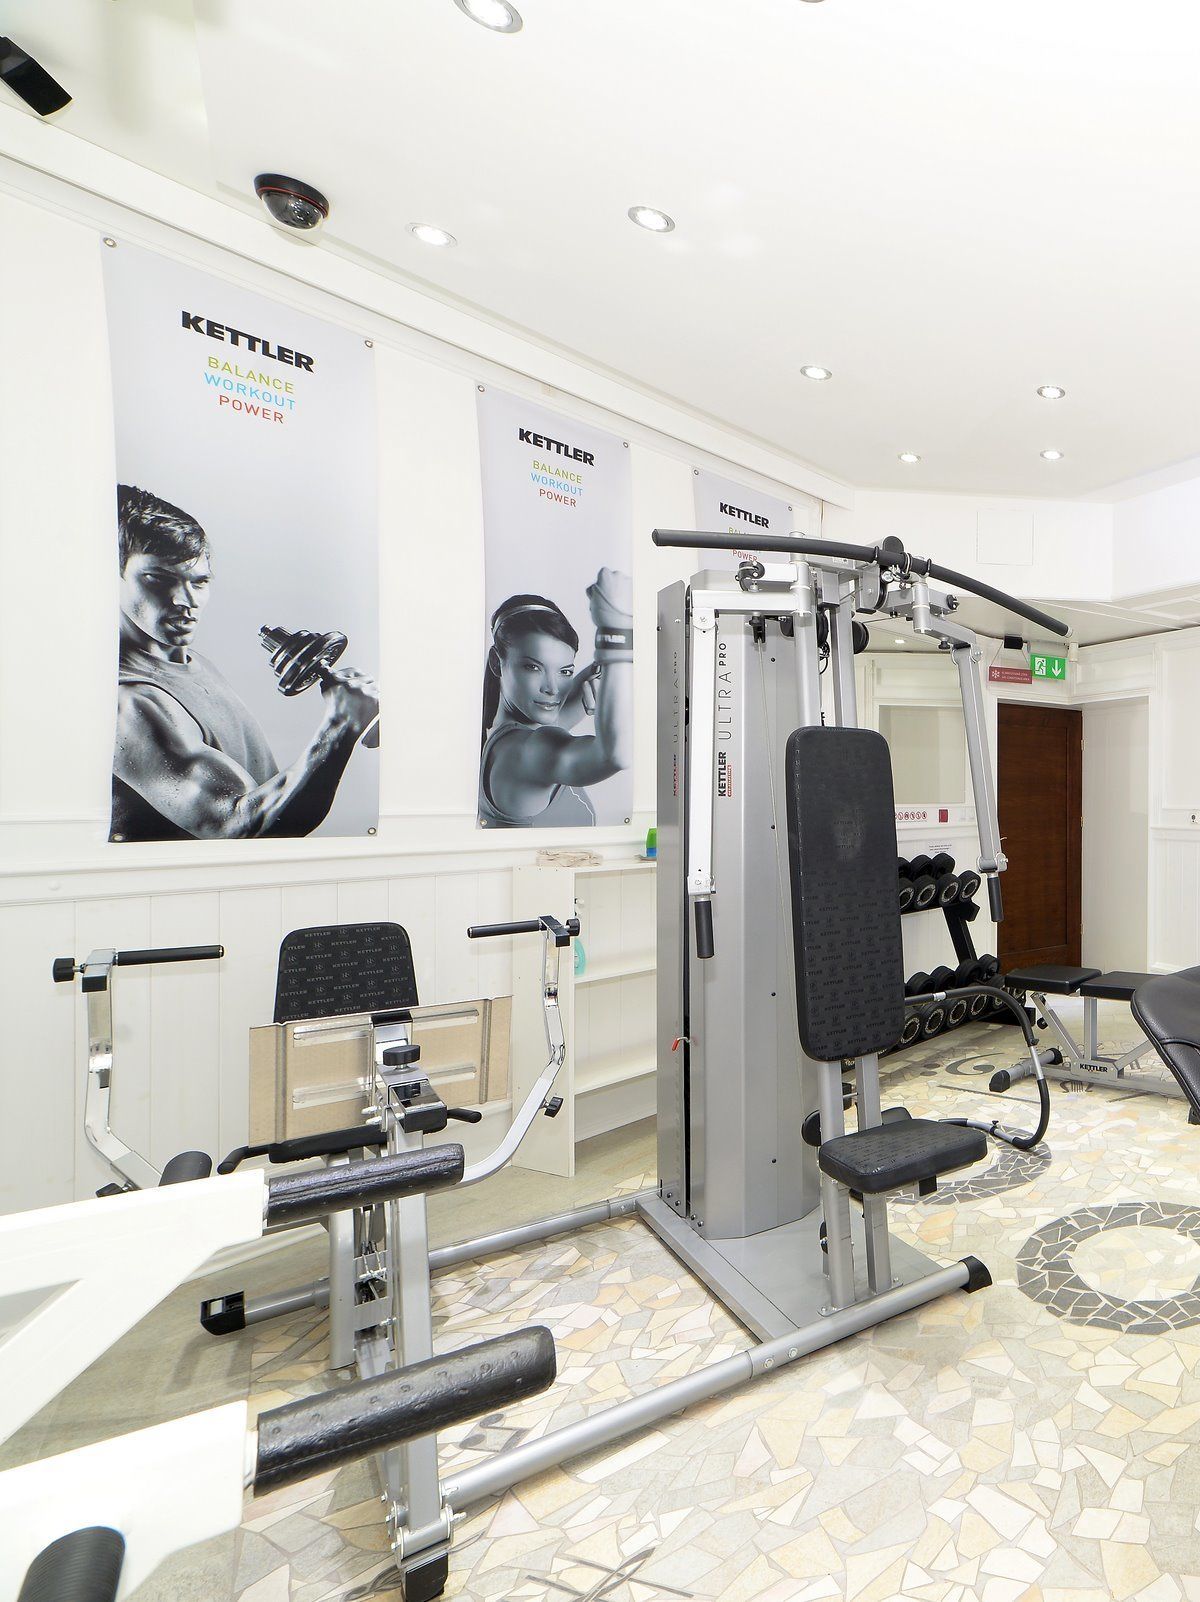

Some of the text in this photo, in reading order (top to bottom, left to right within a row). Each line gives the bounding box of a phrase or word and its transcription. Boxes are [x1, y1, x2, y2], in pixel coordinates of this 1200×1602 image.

[181, 310, 314, 373] KETTLER
[208, 356, 295, 394] BALANCE
[204, 372, 296, 410] WORKOUT
[219, 394, 284, 424] POWER
[519, 427, 595, 467] KETTLER
[530, 472, 583, 497] WORKOUT
[532, 460, 583, 484] BALANCE
[539, 488, 577, 508] POWER
[719, 501, 770, 529] KETTLER
[717, 642, 732, 797] KETTLER ULTRA PRO
[1079, 1063, 1108, 1073] KETTLER
